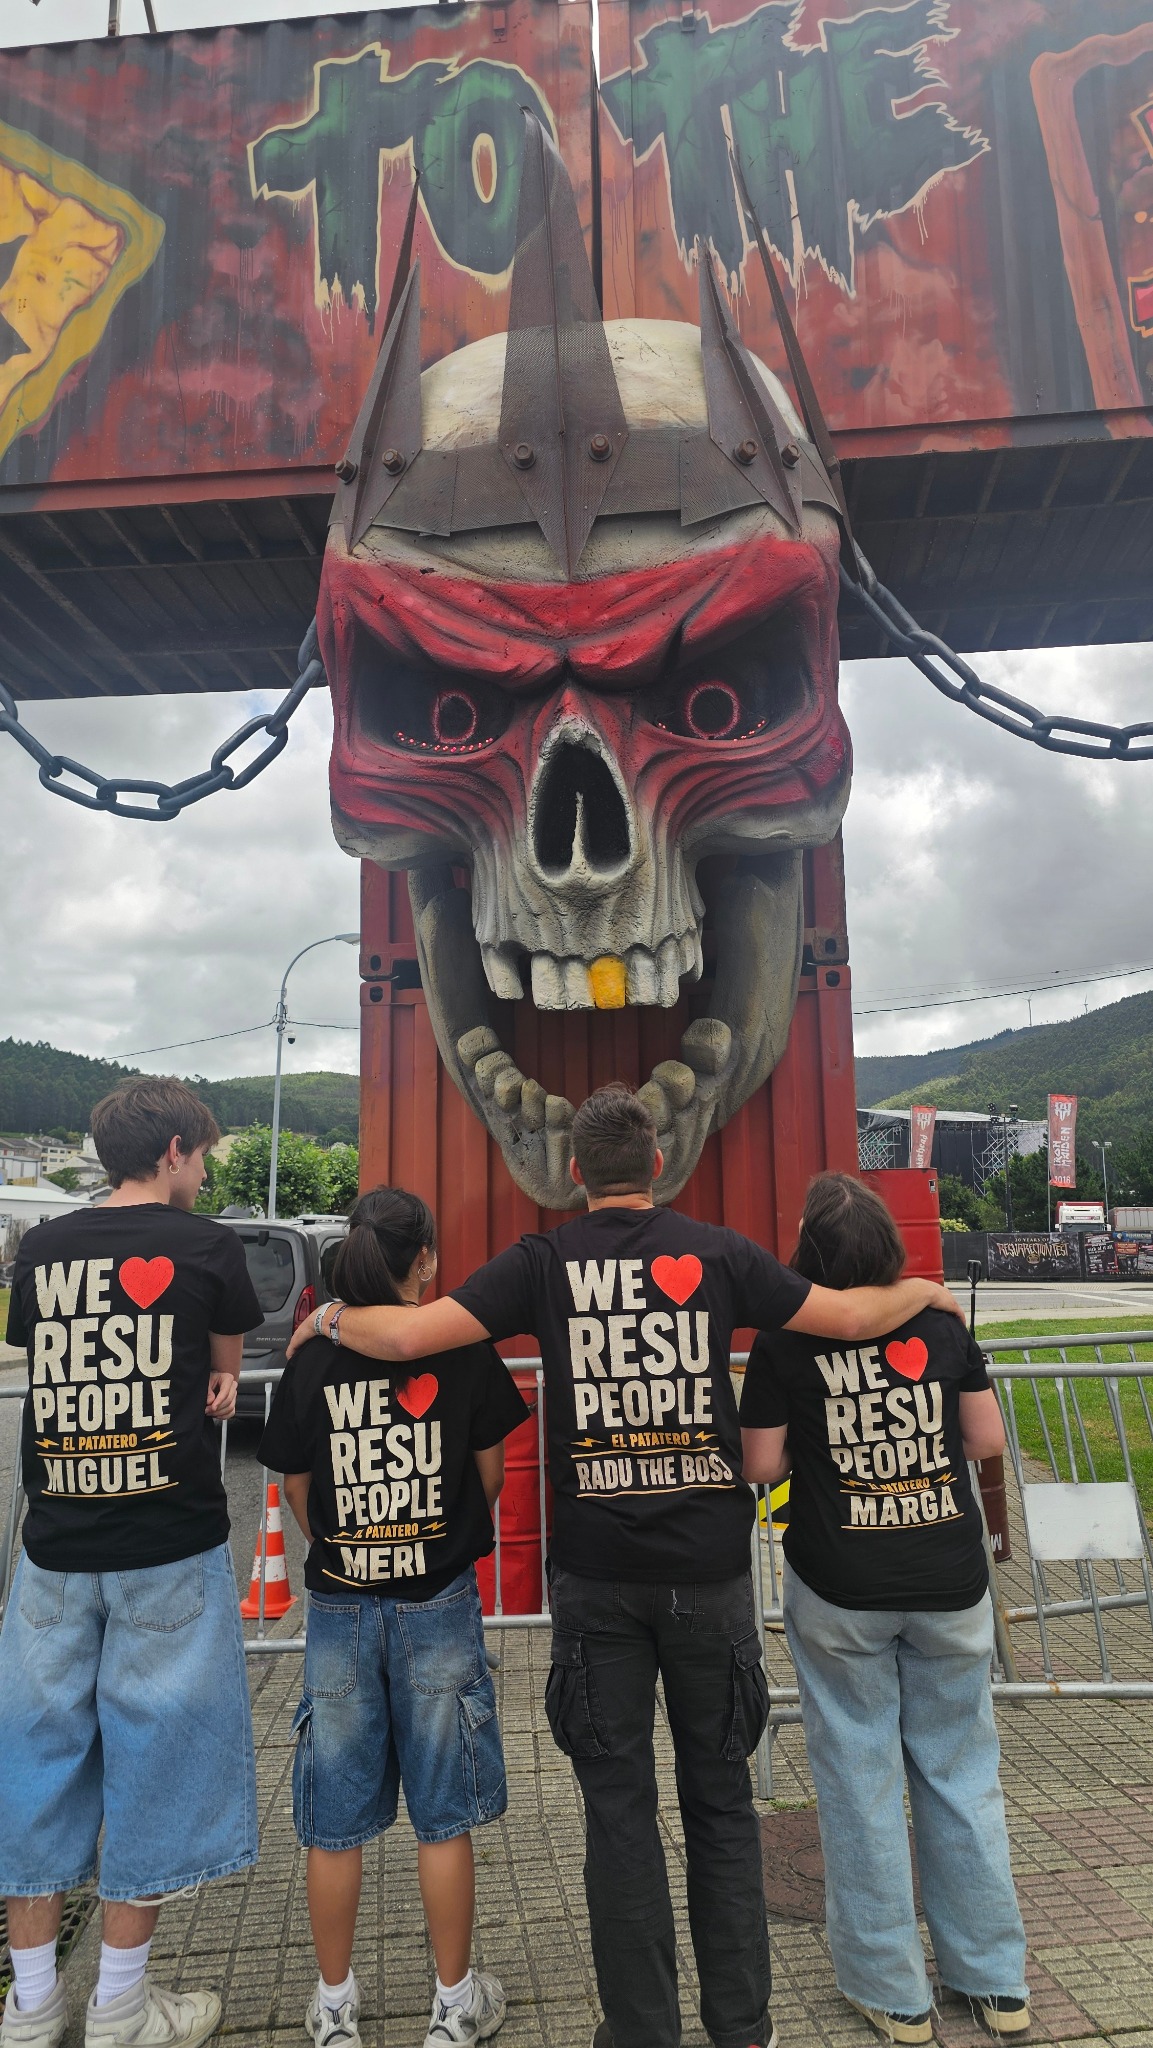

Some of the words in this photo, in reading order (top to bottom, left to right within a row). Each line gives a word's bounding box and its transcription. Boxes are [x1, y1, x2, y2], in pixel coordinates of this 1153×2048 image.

[247, 42, 559, 322] TO
[601, 0, 990, 300] THE
[1053, 1140, 1062, 1166] IRON
[1061, 1127, 1072, 1167] MAIDEN
[996, 1242, 1052, 1258] RESURRECTION
[1051, 1242, 1069, 1257] FEST
[34, 1257, 114, 1319] WE
[565, 1259, 647, 1312] WE
[33, 1314, 175, 1385] RESU
[568, 1311, 709, 1379] RESU
[814, 1345, 890, 1397] WE
[32, 1379, 171, 1434] PEOPLE
[323, 1378, 392, 1431] WE
[573, 1378, 713, 1430] PEOPLE
[823, 1381, 943, 1445] RESU
[62, 1436, 76, 1451] EL
[78, 1433, 138, 1451] PATATERO
[329, 1420, 442, 1486] RESU
[611, 1433, 627, 1448] EL
[630, 1431, 691, 1448] PATATERO
[830, 1430, 951, 1480] PEOPLE
[43, 1451, 169, 1494] MIGUEL
[575, 1457, 633, 1491] RADU
[636, 1455, 678, 1487] THE
[681, 1452, 733, 1482] BOSS
[335, 1475, 443, 1528] PEOPLE
[850, 1485, 959, 1526] MARGA
[365, 1522, 419, 1539] PATATERO
[339, 1541, 426, 1582] MERI
